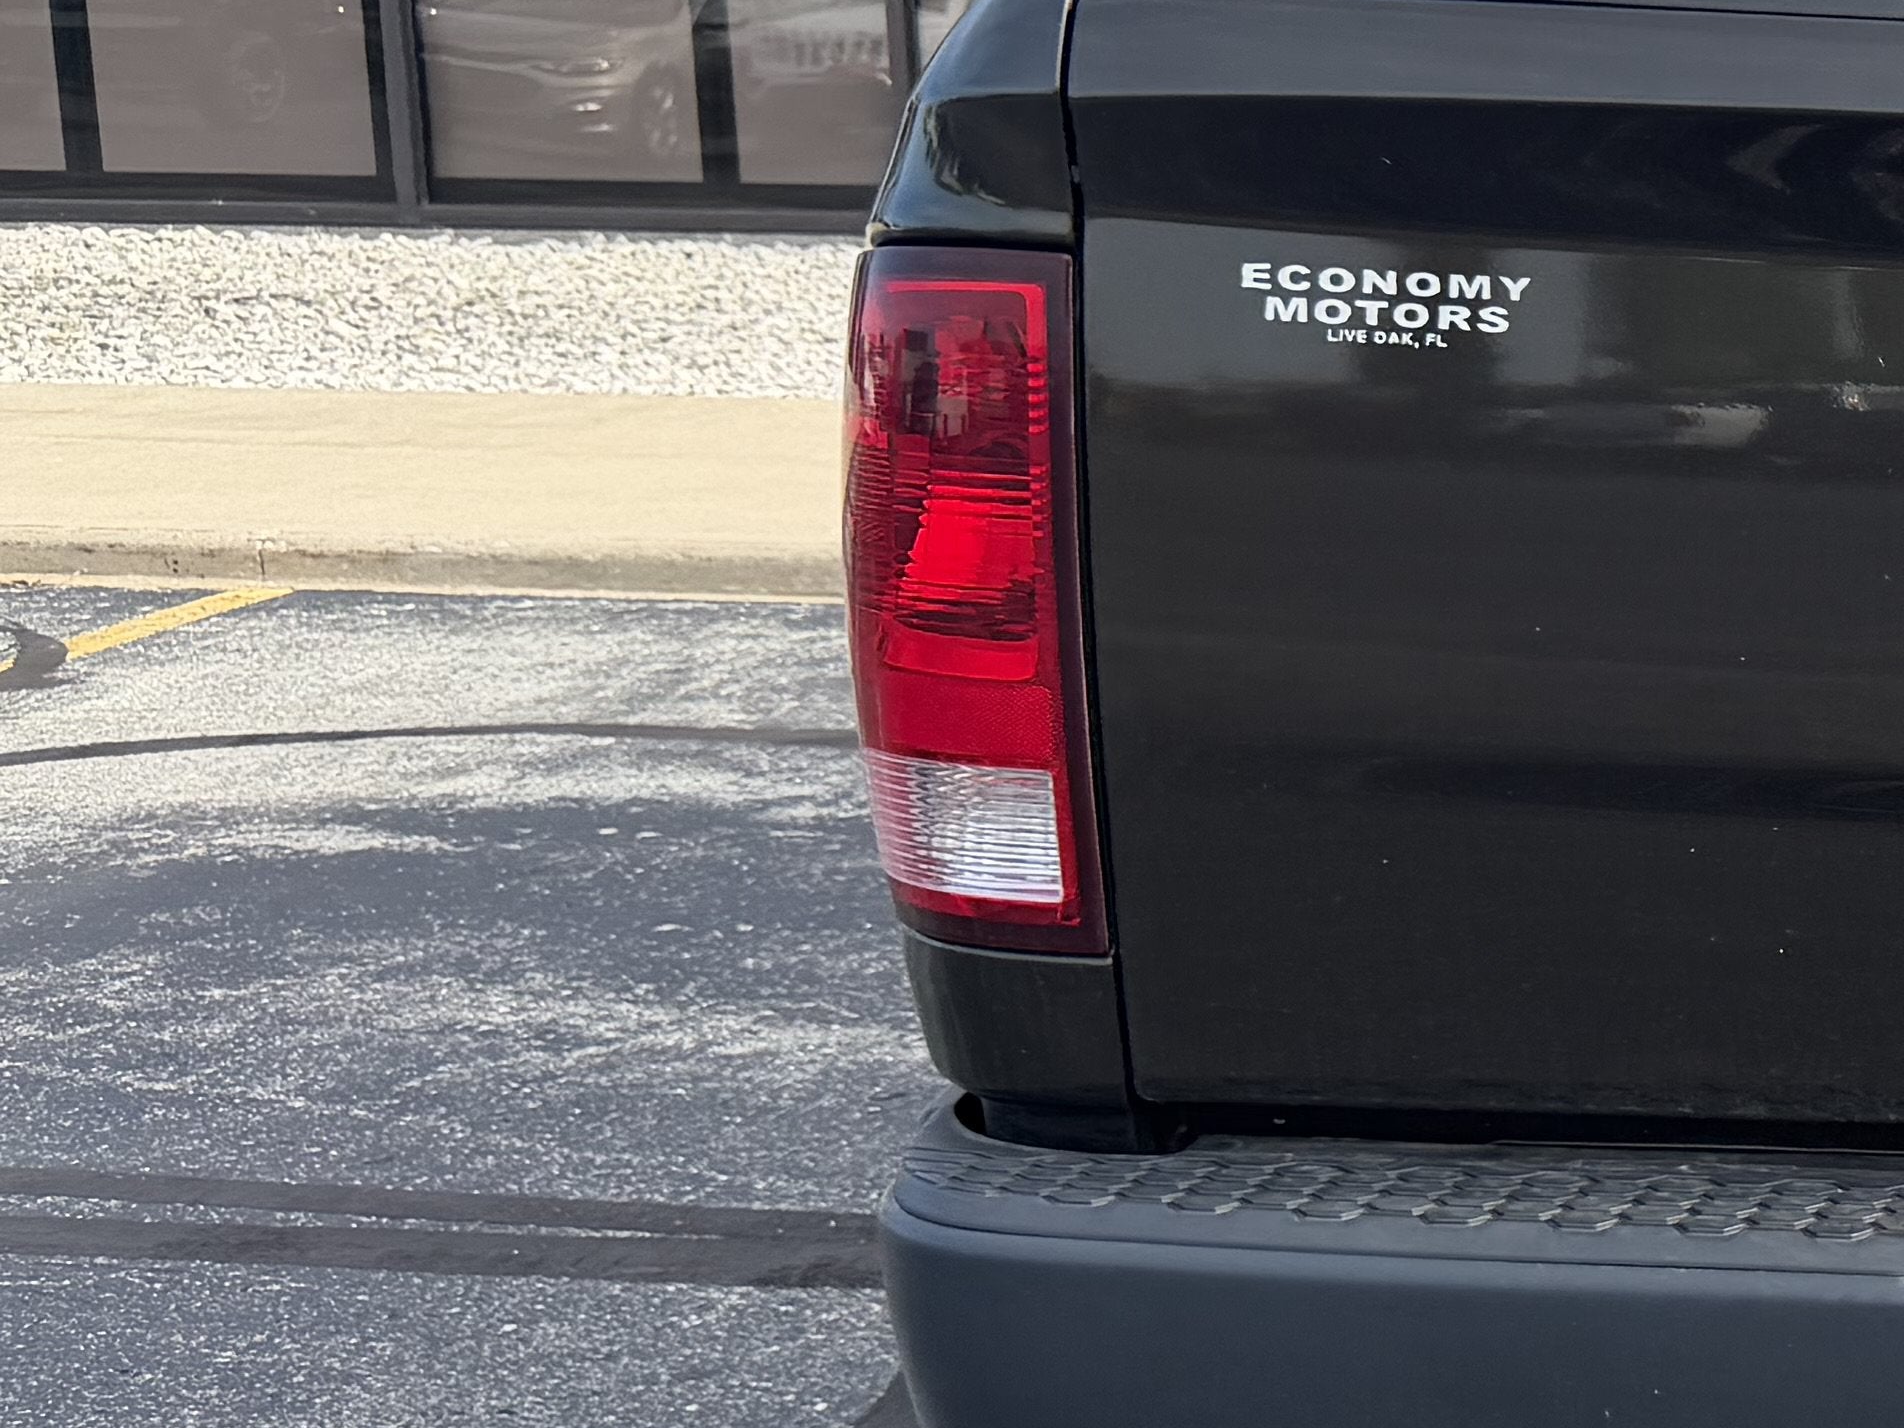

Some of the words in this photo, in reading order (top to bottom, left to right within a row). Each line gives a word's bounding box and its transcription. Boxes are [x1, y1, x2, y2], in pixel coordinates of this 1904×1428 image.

[1240, 262, 1532, 302] ECONOMY
[1263, 295, 1511, 334] MOTORS
[1326, 327, 1368, 344] LIVE
[1373, 330, 1421, 350] OAK,
[1425, 332, 1449, 348] FL
